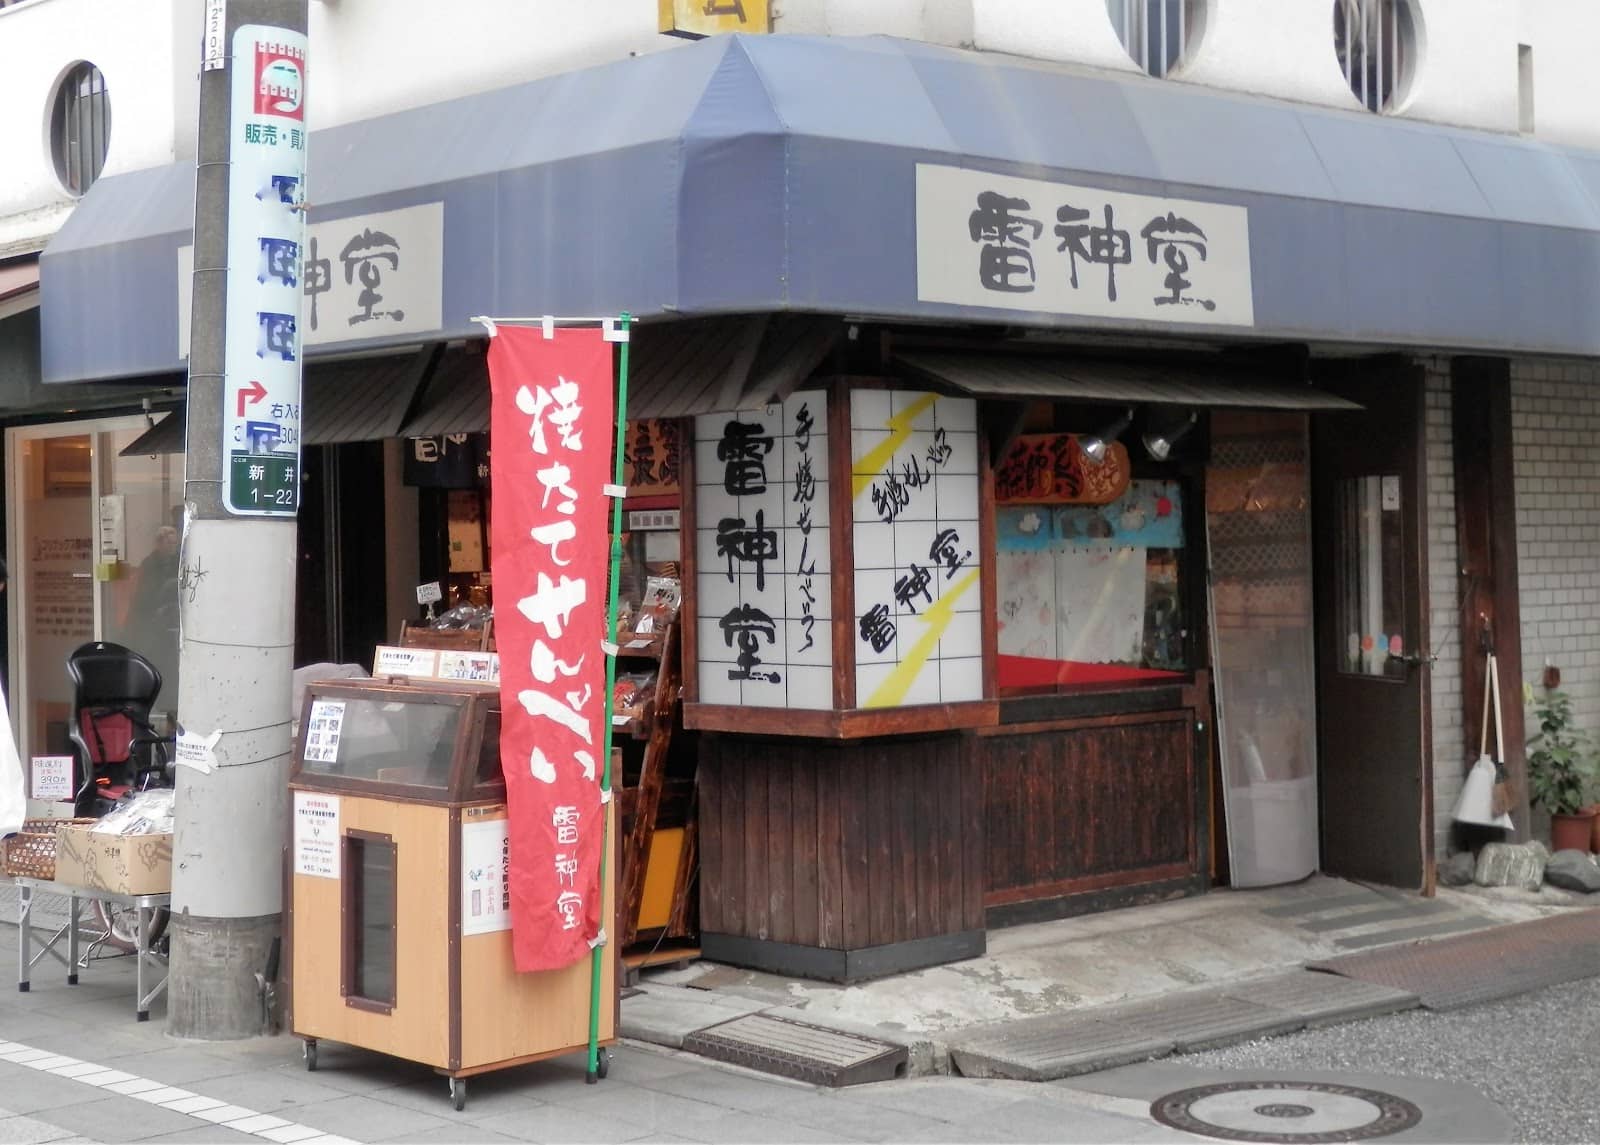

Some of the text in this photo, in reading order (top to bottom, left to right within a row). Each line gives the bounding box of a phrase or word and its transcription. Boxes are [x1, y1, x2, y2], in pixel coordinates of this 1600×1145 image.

[969, 191, 1216, 311] 雷神堂
[248, 464, 294, 482] 新井
[716, 420, 781, 683] 雷神堂
[860, 529, 972, 653] 雷神堂
[552, 806, 582, 930] 雷神堂
